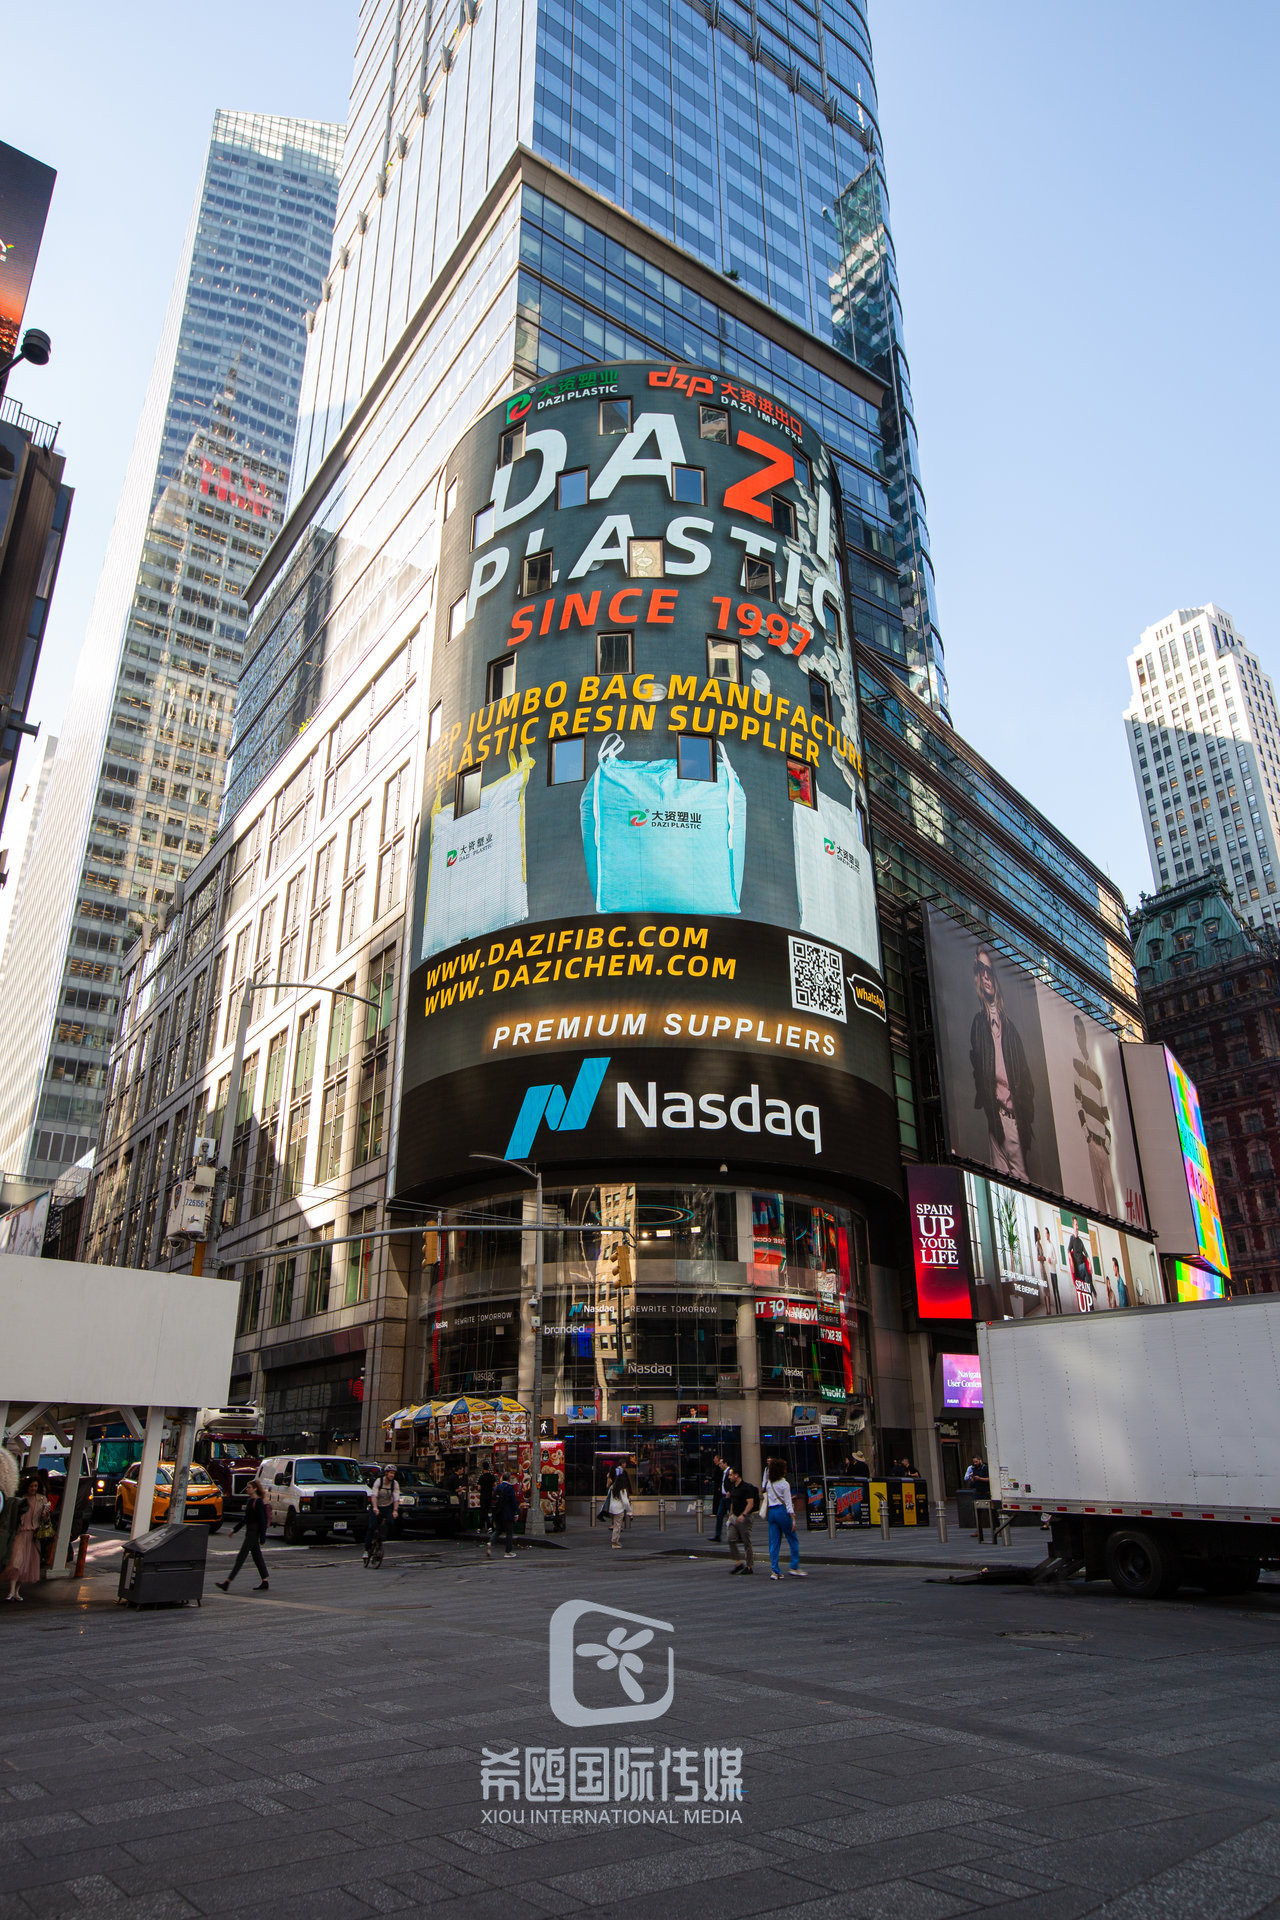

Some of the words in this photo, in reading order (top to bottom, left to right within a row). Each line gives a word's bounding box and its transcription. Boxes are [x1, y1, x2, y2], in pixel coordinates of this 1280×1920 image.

[537, 370, 619, 400] 大资塑业
[649, 366, 713, 397] dzp
[537, 394, 565, 410] DAZI
[567, 385, 618, 400] PLASTIC
[721, 382, 802, 436] 大资进出口
[720, 395, 752, 414] DAZI
[757, 411, 803, 444] IMP/EXP
[489, 412, 832, 564] DAZI
[465, 513, 843, 630] PLASTIC
[506, 588, 679, 647] SINCE
[712, 596, 811, 656] 1997
[463, 680, 567, 748] JUMBO
[578, 674, 656, 702] BAG
[435, 716, 540, 790] PLASTIC
[548, 705, 657, 739] RESIN
[669, 705, 821, 768] SUPPLIER
[651, 810, 702, 825] 大资塑业
[460, 833, 493, 854] 大资塑业
[426, 925, 709, 990] WWW.DAZIFIBC.COM
[492, 1012, 648, 1050] PREMIUM
[663, 1012, 836, 1056] SUPPLIERS
[616, 1082, 824, 1155] Nasdaq
[916, 1203, 953, 1217] SPAIN
[917, 1215, 954, 1238] UP
[919, 1237, 957, 1250] YOUR
[921, 1250, 959, 1265] LIFE
[1075, 1279, 1091, 1293] SPAIN
[583, 1305, 615, 1315] Nasdaq
[630, 1305, 667, 1313] REWRITE
[671, 1305, 718, 1314] TOMORROW
[1077, 1291, 1093, 1312] UP
[628, 1363, 673, 1377] Nasdaq
